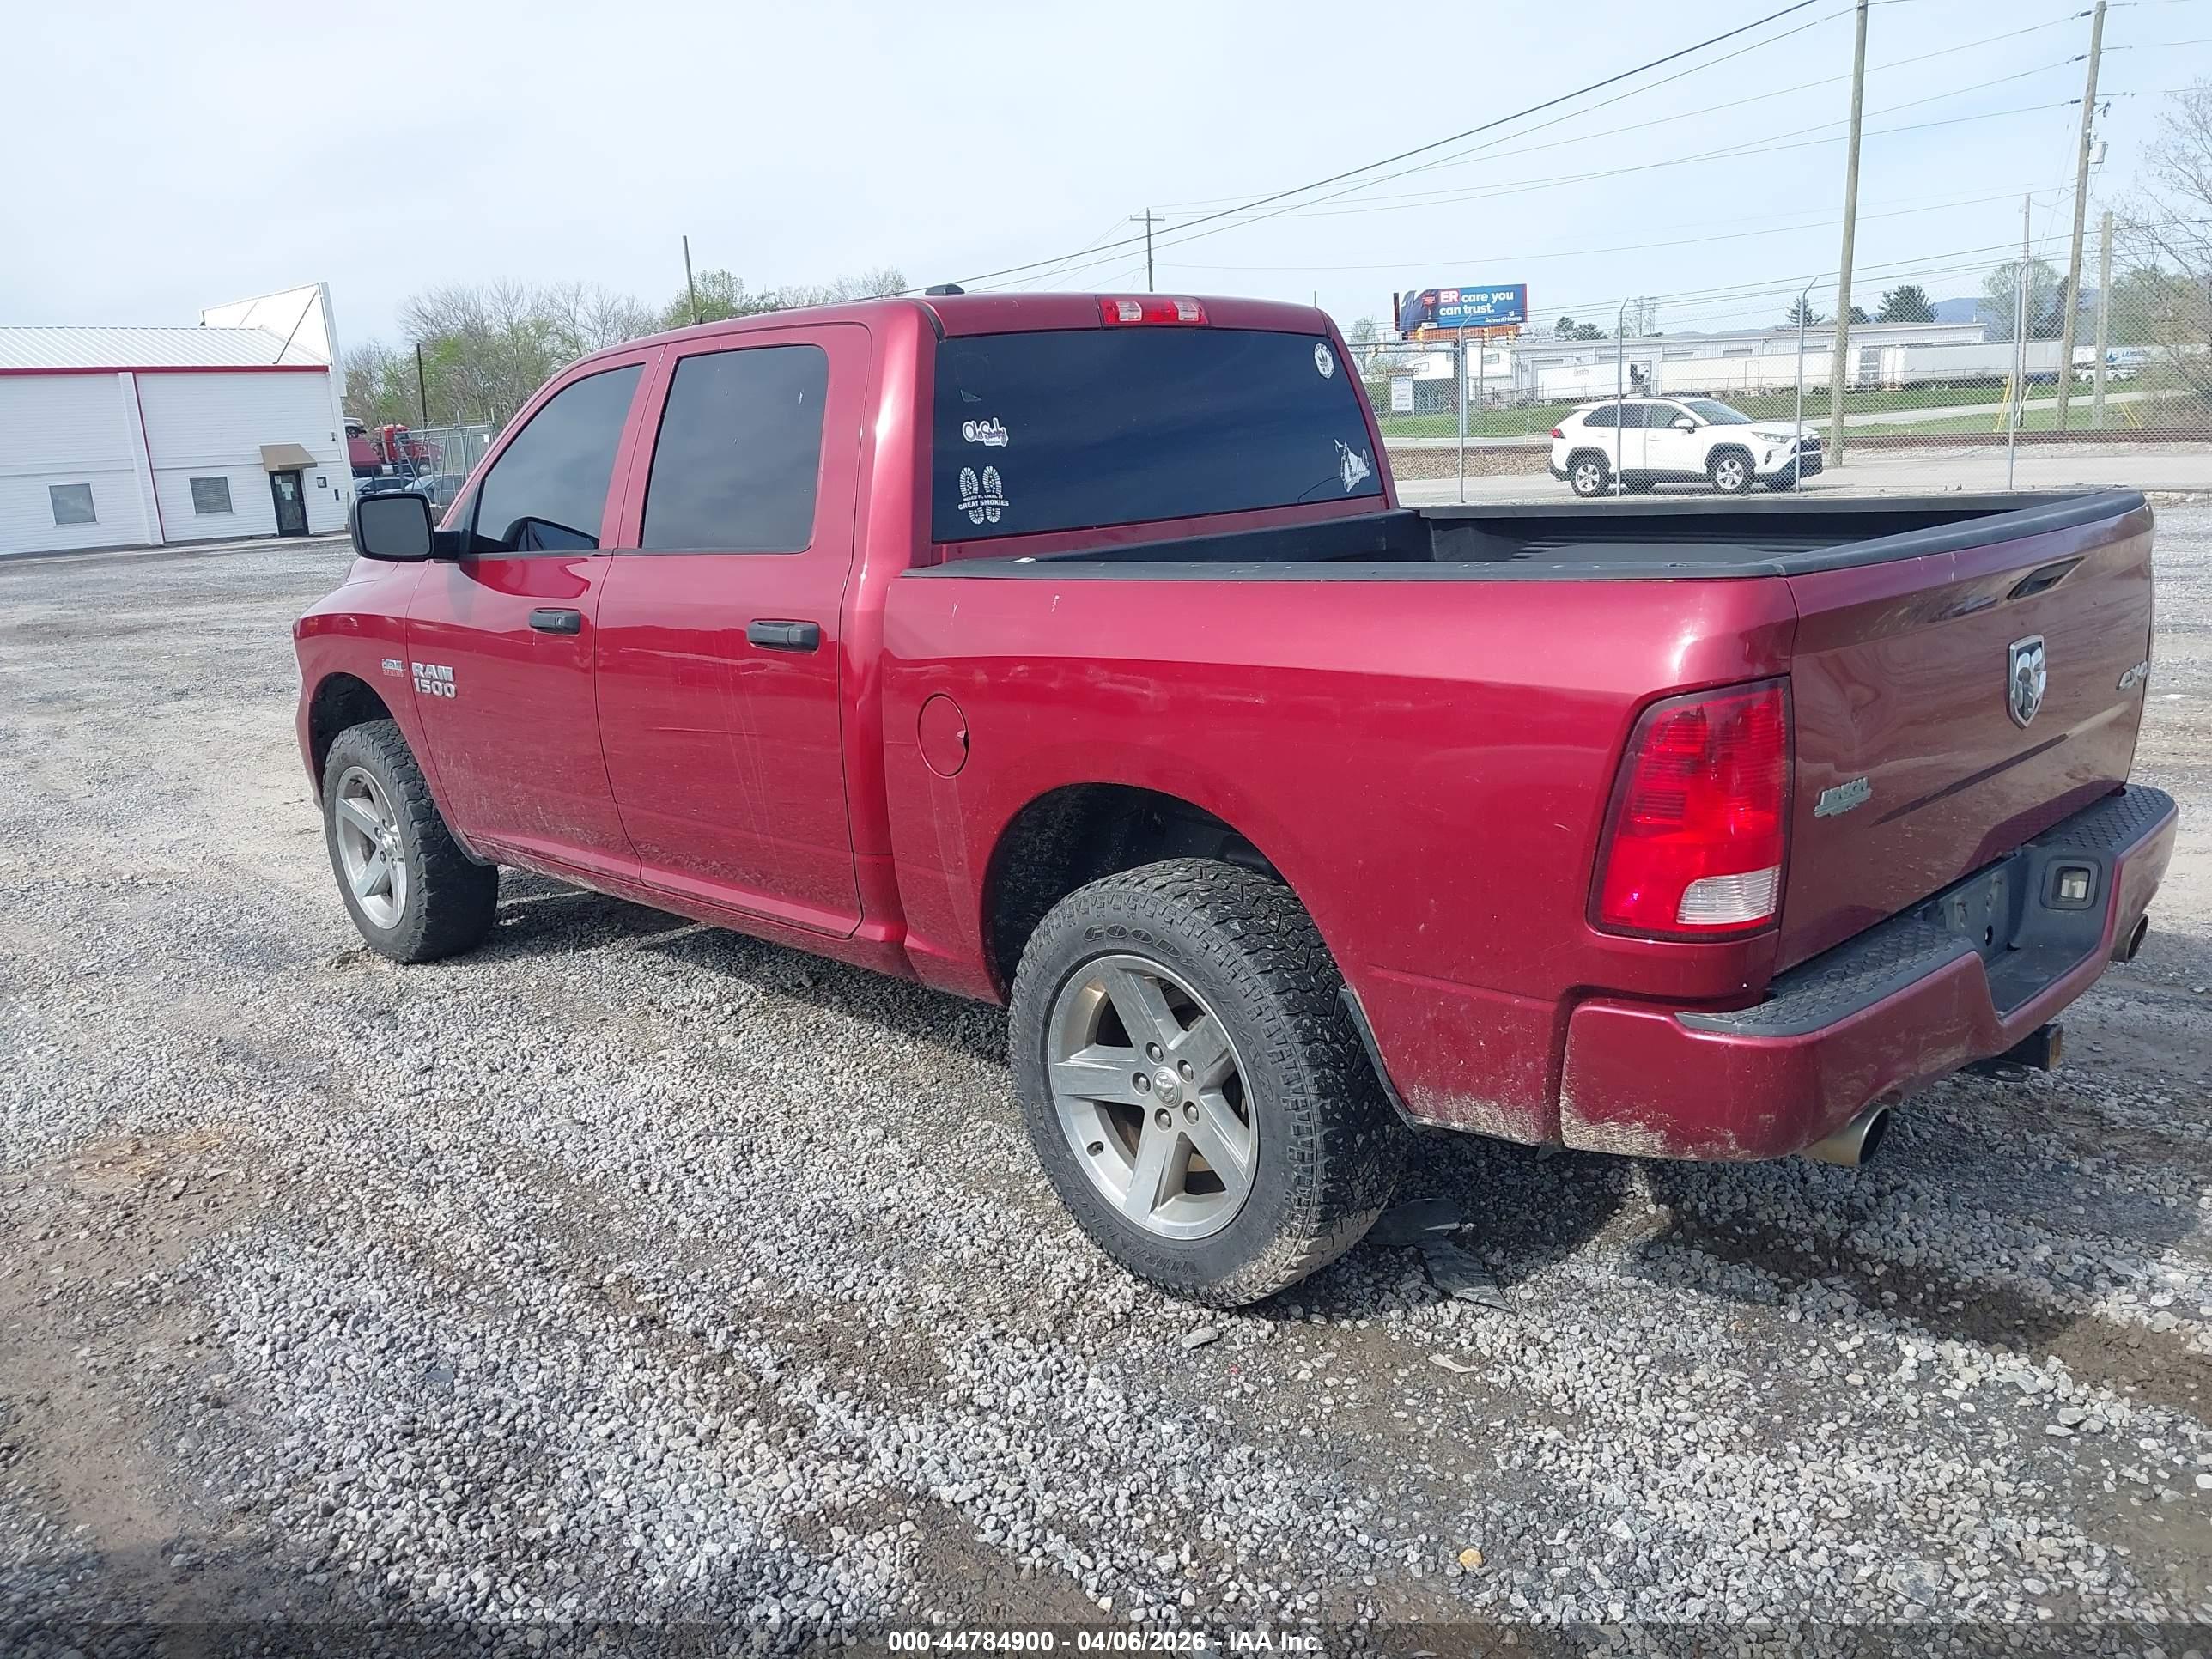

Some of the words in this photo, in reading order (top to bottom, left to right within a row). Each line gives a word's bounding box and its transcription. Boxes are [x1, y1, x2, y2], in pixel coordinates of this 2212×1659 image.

[1440, 290, 1459, 303] ER
[1461, 292, 1487, 303] care
[1492, 291, 1514, 304] you
[1439, 306, 1462, 316] can
[1463, 302, 1495, 315] trust.
[958, 500, 978, 510] GREAT
[411, 662, 455, 682] RAM
[413, 678, 457, 699] 1500
[1083, 923, 1275, 1103] GOODYEAR
